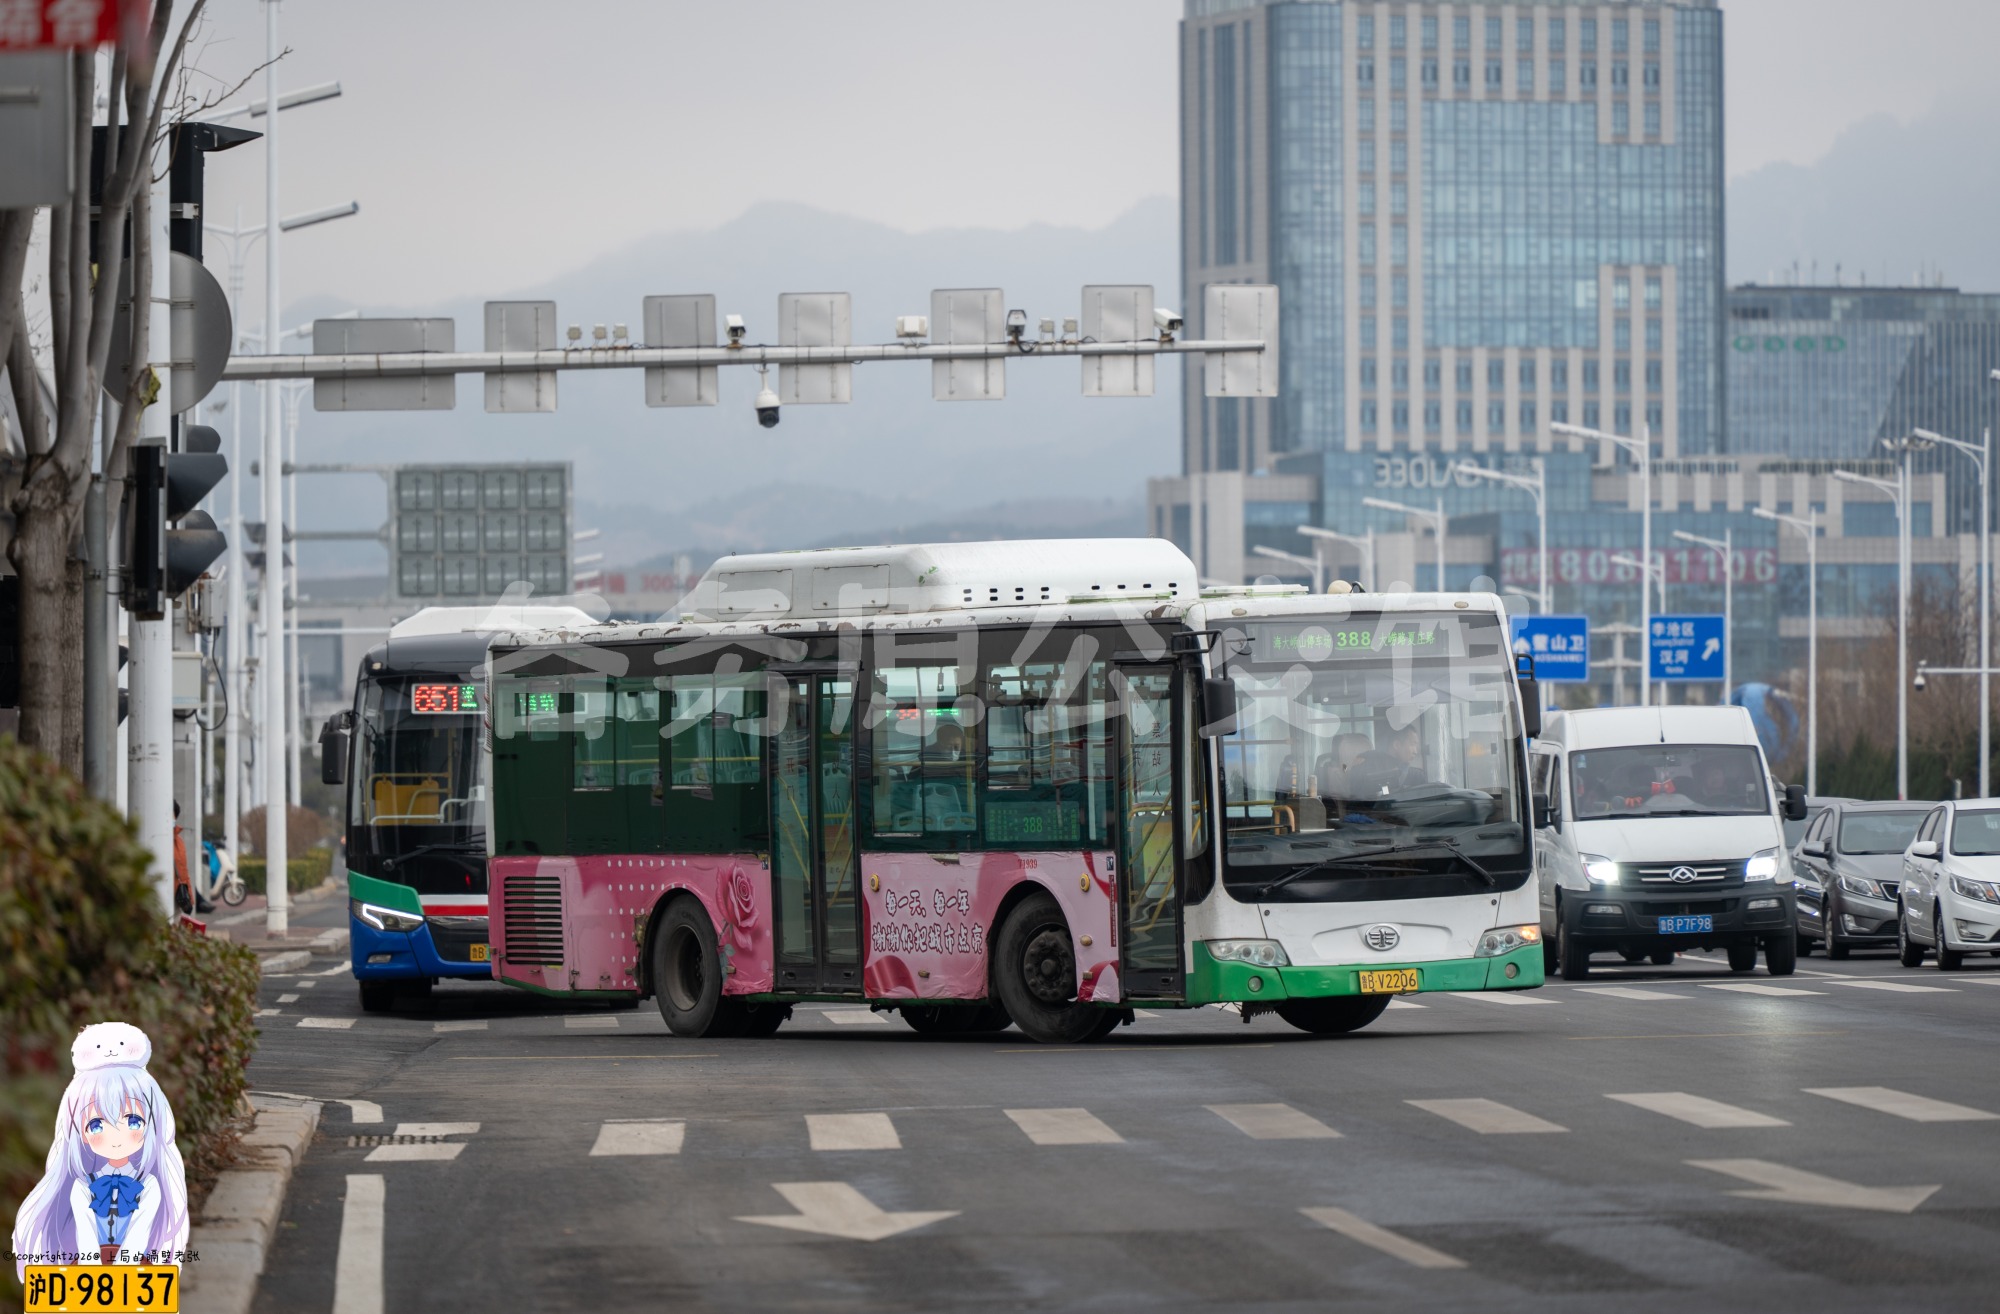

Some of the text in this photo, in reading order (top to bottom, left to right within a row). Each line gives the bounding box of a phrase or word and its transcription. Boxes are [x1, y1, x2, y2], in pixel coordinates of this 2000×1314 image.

[1336, 631, 1371, 648] 388
[415, 686, 458, 712] 651
[1023, 816, 1043, 833] 388
[933, 889, 970, 917] 每一年
[872, 921, 983, 955] 谢谢你把城市点亮
